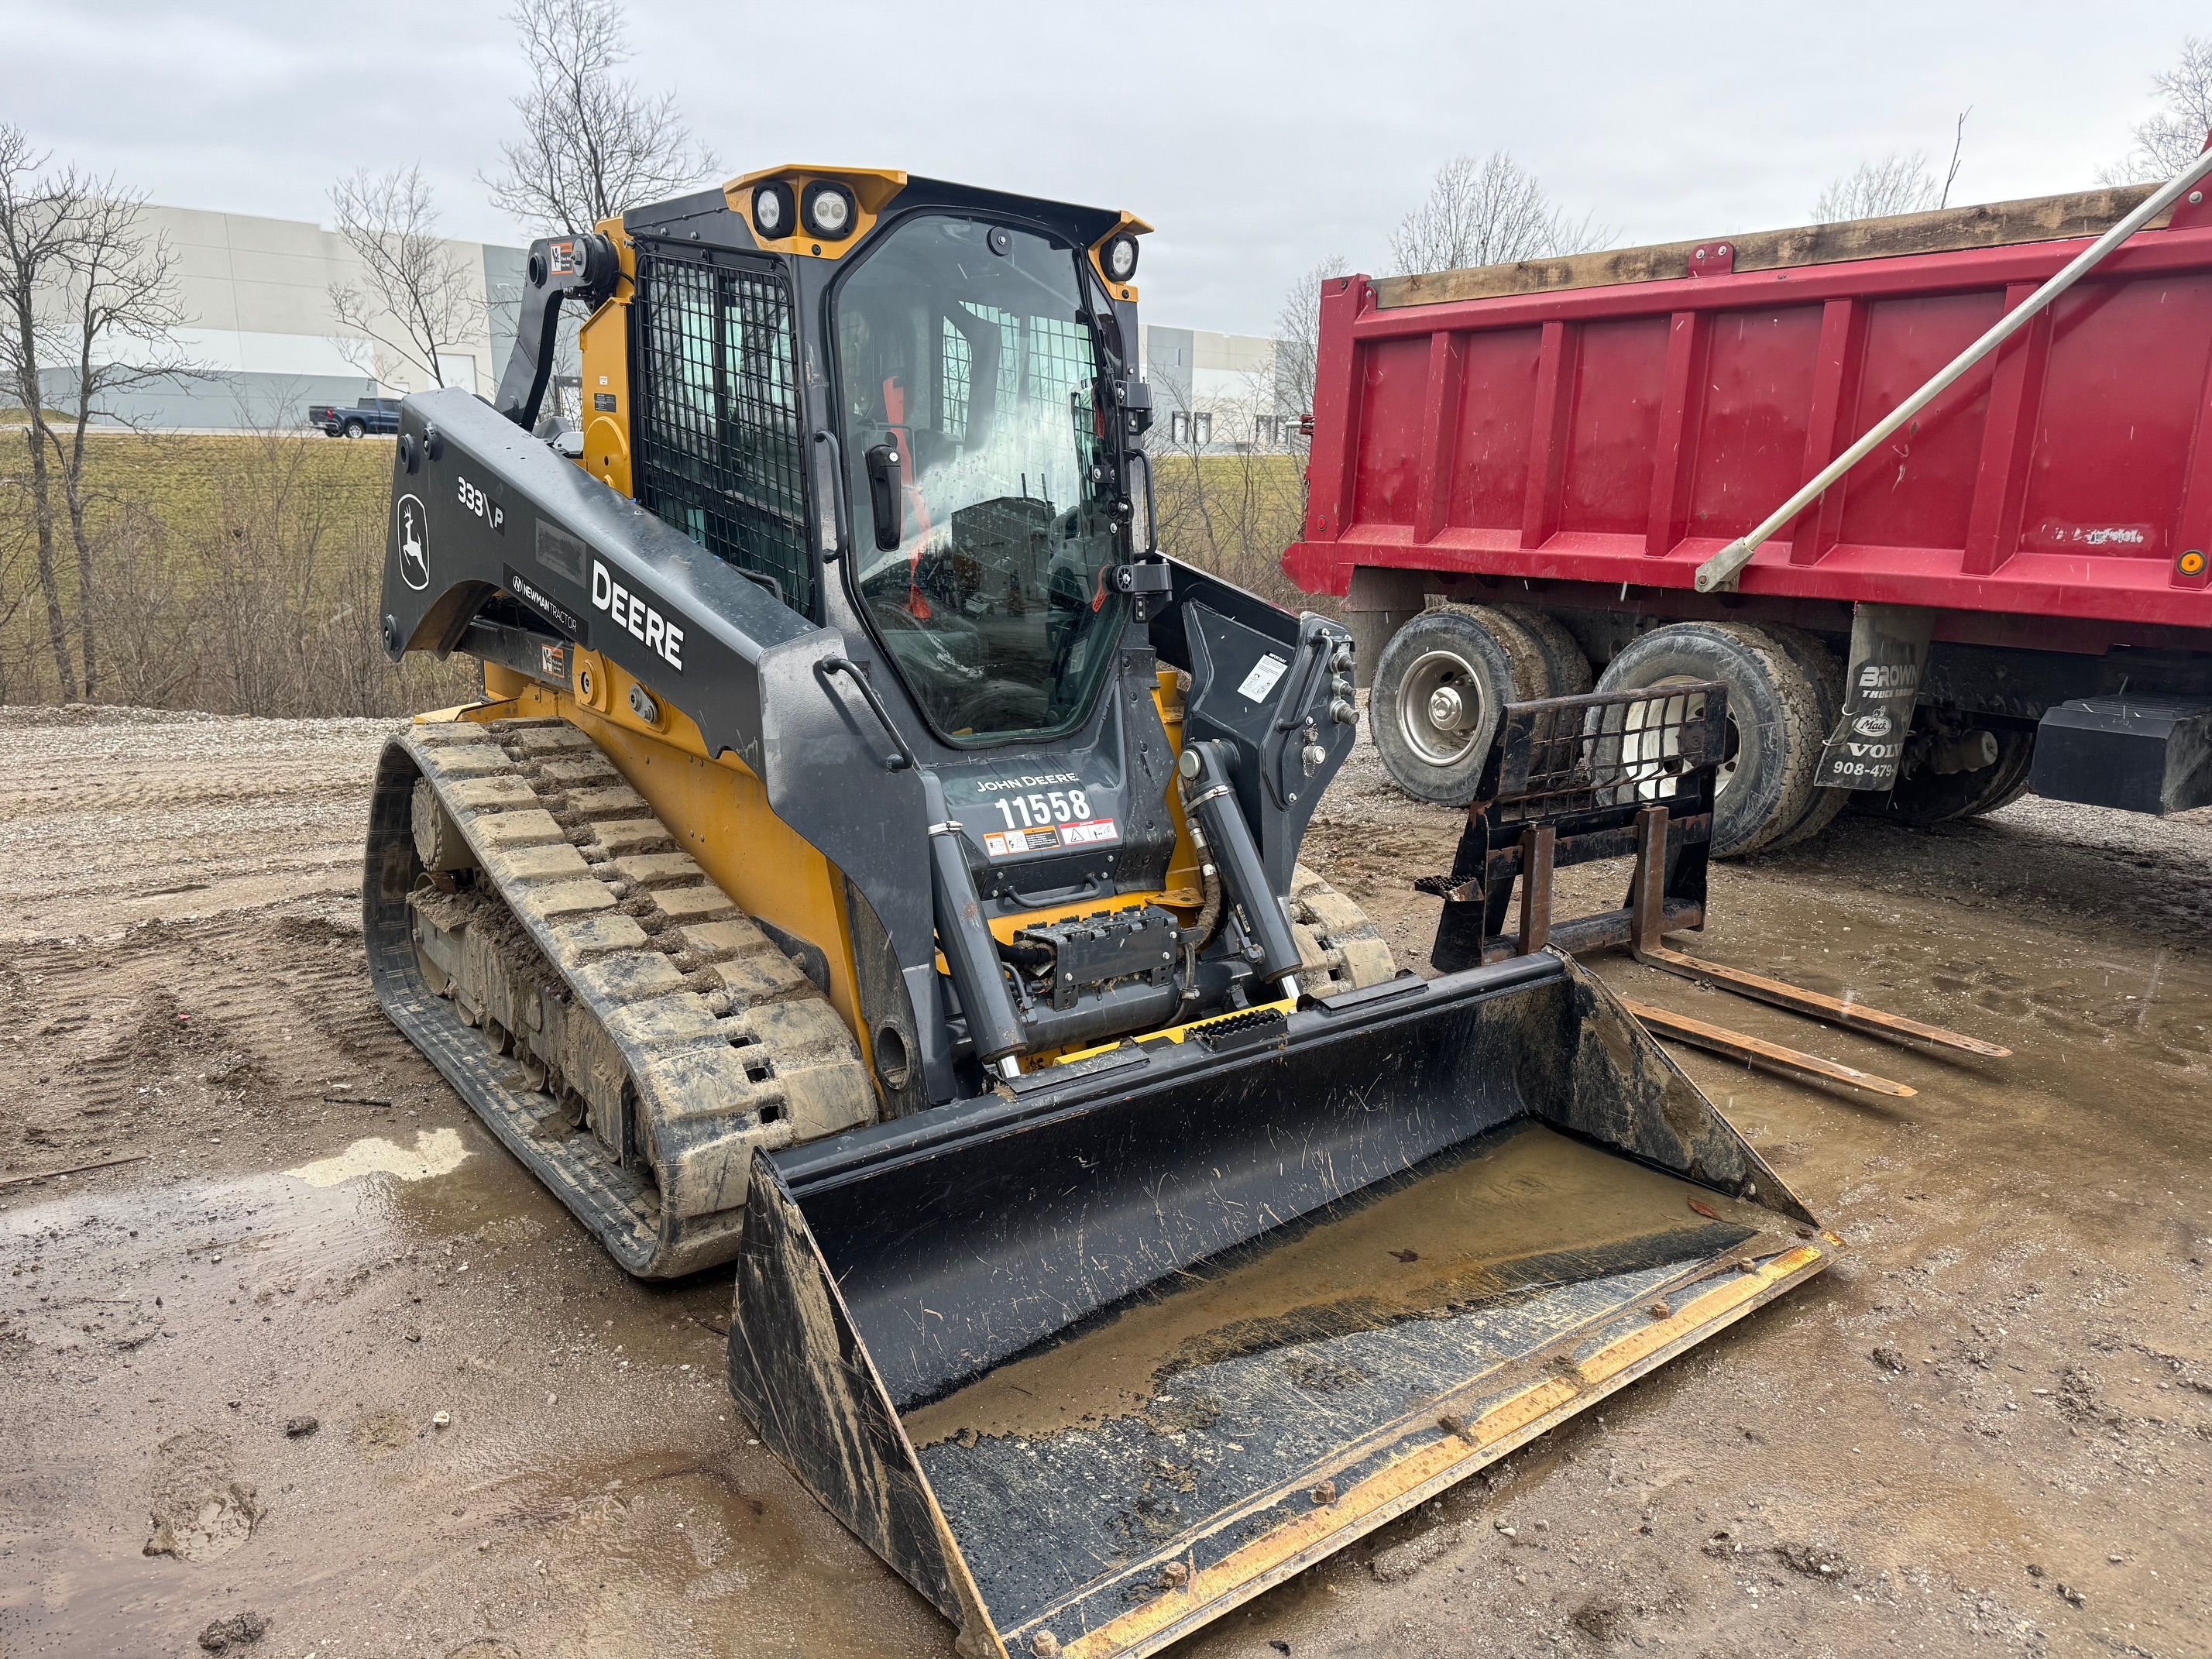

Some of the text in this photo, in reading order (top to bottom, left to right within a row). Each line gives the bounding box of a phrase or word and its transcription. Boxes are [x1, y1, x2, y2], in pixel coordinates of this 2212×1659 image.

[592, 558, 685, 672] DEERE
[1859, 665, 1918, 687] BROWN
[1862, 689, 1894, 698] TRUCK
[1860, 720, 1887, 730] Mack
[976, 772, 1080, 793] JOHN DEERE
[994, 789, 1091, 830] 11558
